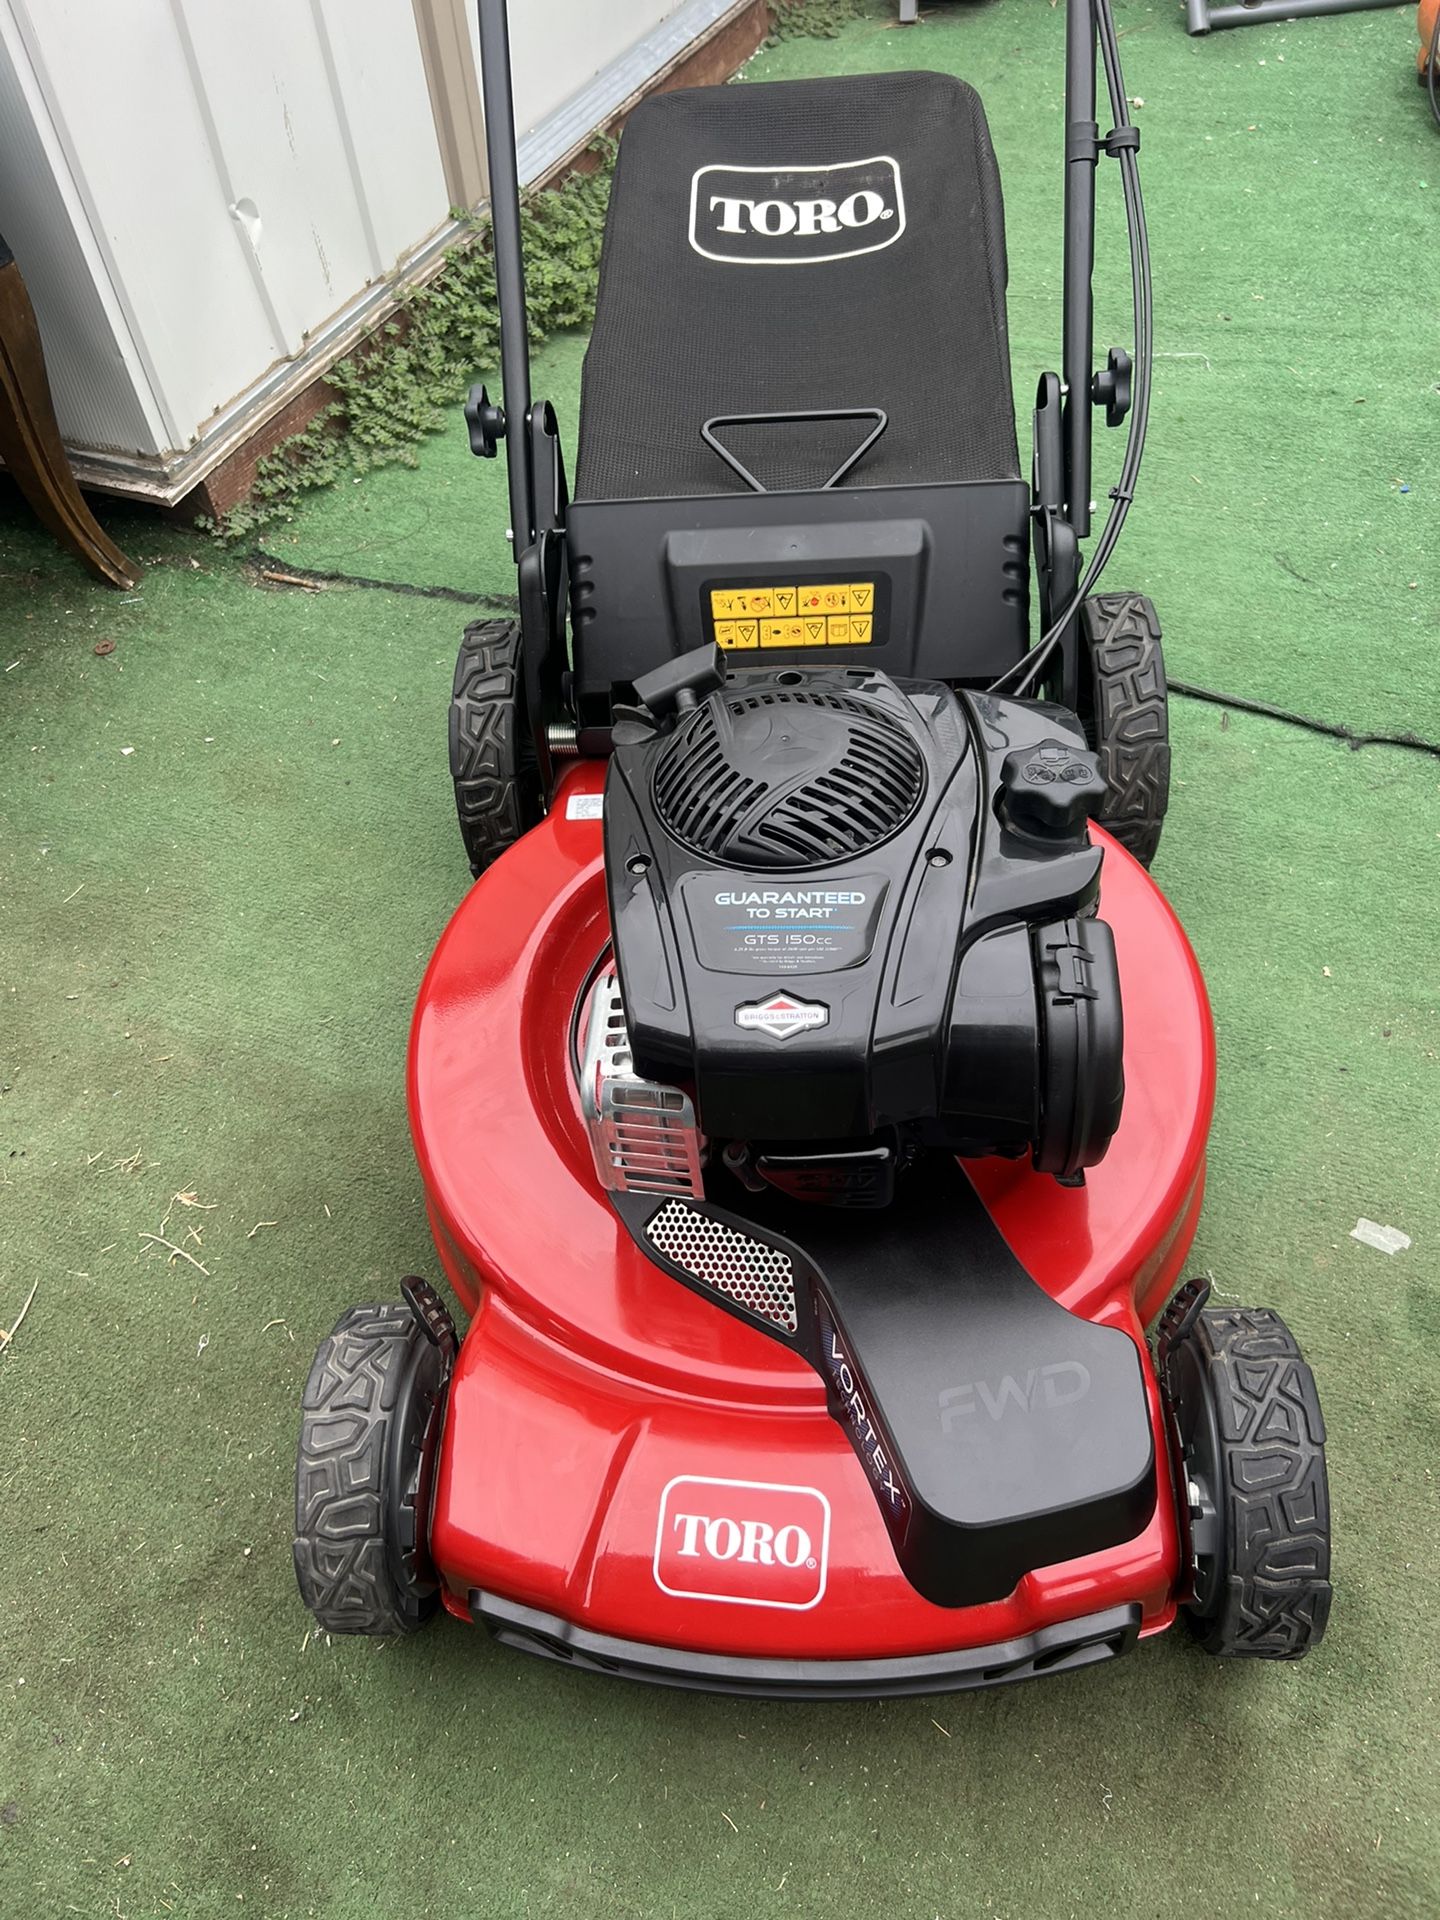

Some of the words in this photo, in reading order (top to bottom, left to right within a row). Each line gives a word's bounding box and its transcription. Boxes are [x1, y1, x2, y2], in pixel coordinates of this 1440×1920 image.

[714, 891, 866, 906] GUARANTEED
[746, 908, 771, 918] TO
[744, 934, 779, 945] GTS
[785, 934, 833, 945] 150cc
[937, 1360, 1092, 1433] FWD
[831, 1332, 901, 1504] VORTEX
